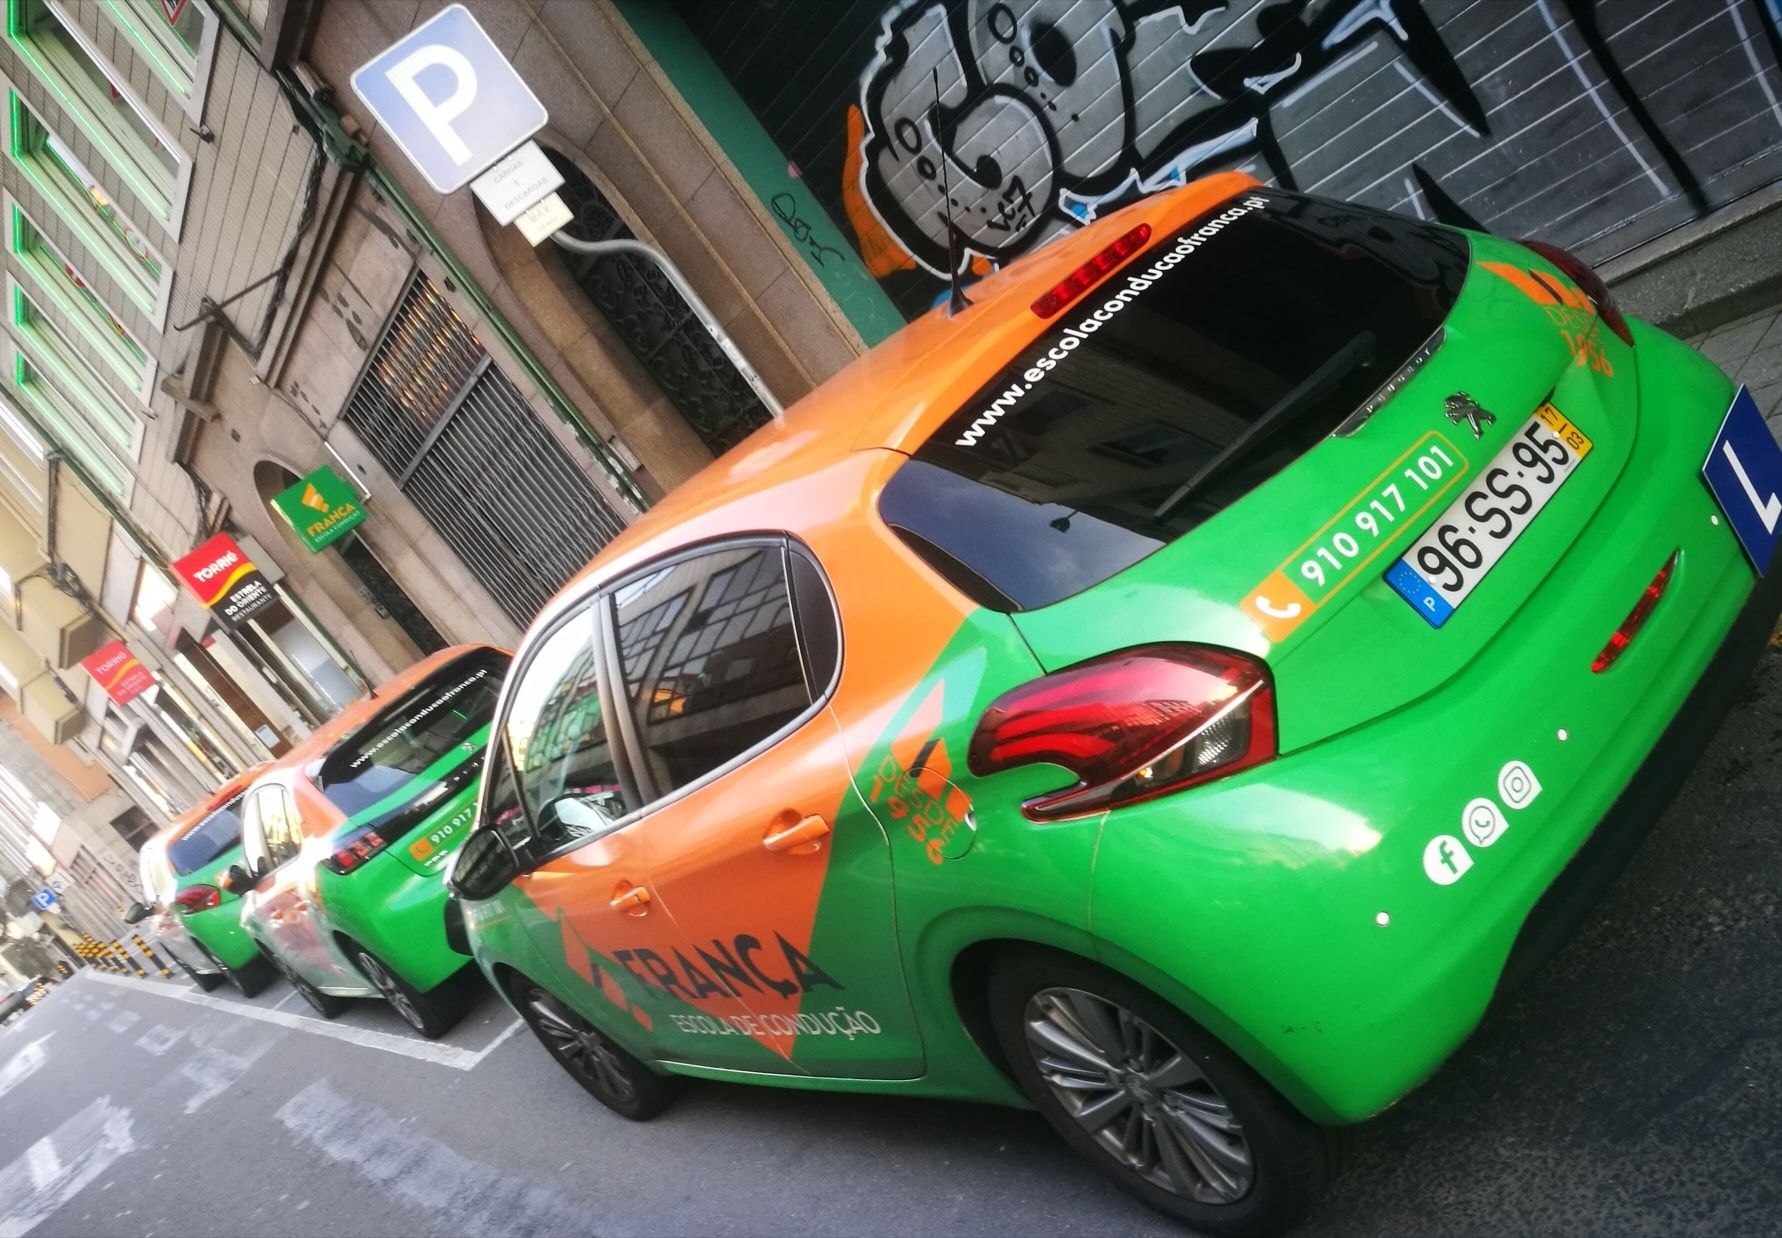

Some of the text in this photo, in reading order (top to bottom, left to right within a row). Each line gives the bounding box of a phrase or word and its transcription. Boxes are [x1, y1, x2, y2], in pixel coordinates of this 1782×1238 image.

[385, 44, 477, 167] P
[492, 159, 525, 185] CARGAS
[503, 176, 549, 211] DESCARGAS
[955, 195, 1271, 448] www.escolaconducaofranca.pt
[1540, 405, 1561, 427] 17
[1566, 431, 1585, 451] 03
[1722, 439, 1782, 536] L
[1300, 444, 1455, 588] 910 917 101
[224, 586, 268, 617] DO ORIENTE
[229, 580, 262, 603] ESTRELA
[230, 592, 273, 623] RESTAURANTE
[1422, 596, 1438, 612] P
[878, 753, 959, 845] DESDE
[430, 808, 473, 844] 910 917
[869, 775, 945, 866] 1956
[33, 892, 50, 908] P
[612, 930, 846, 1000] FRANÇA
[668, 1006, 882, 1041] ESCOLA DE CONDUÇÃO
